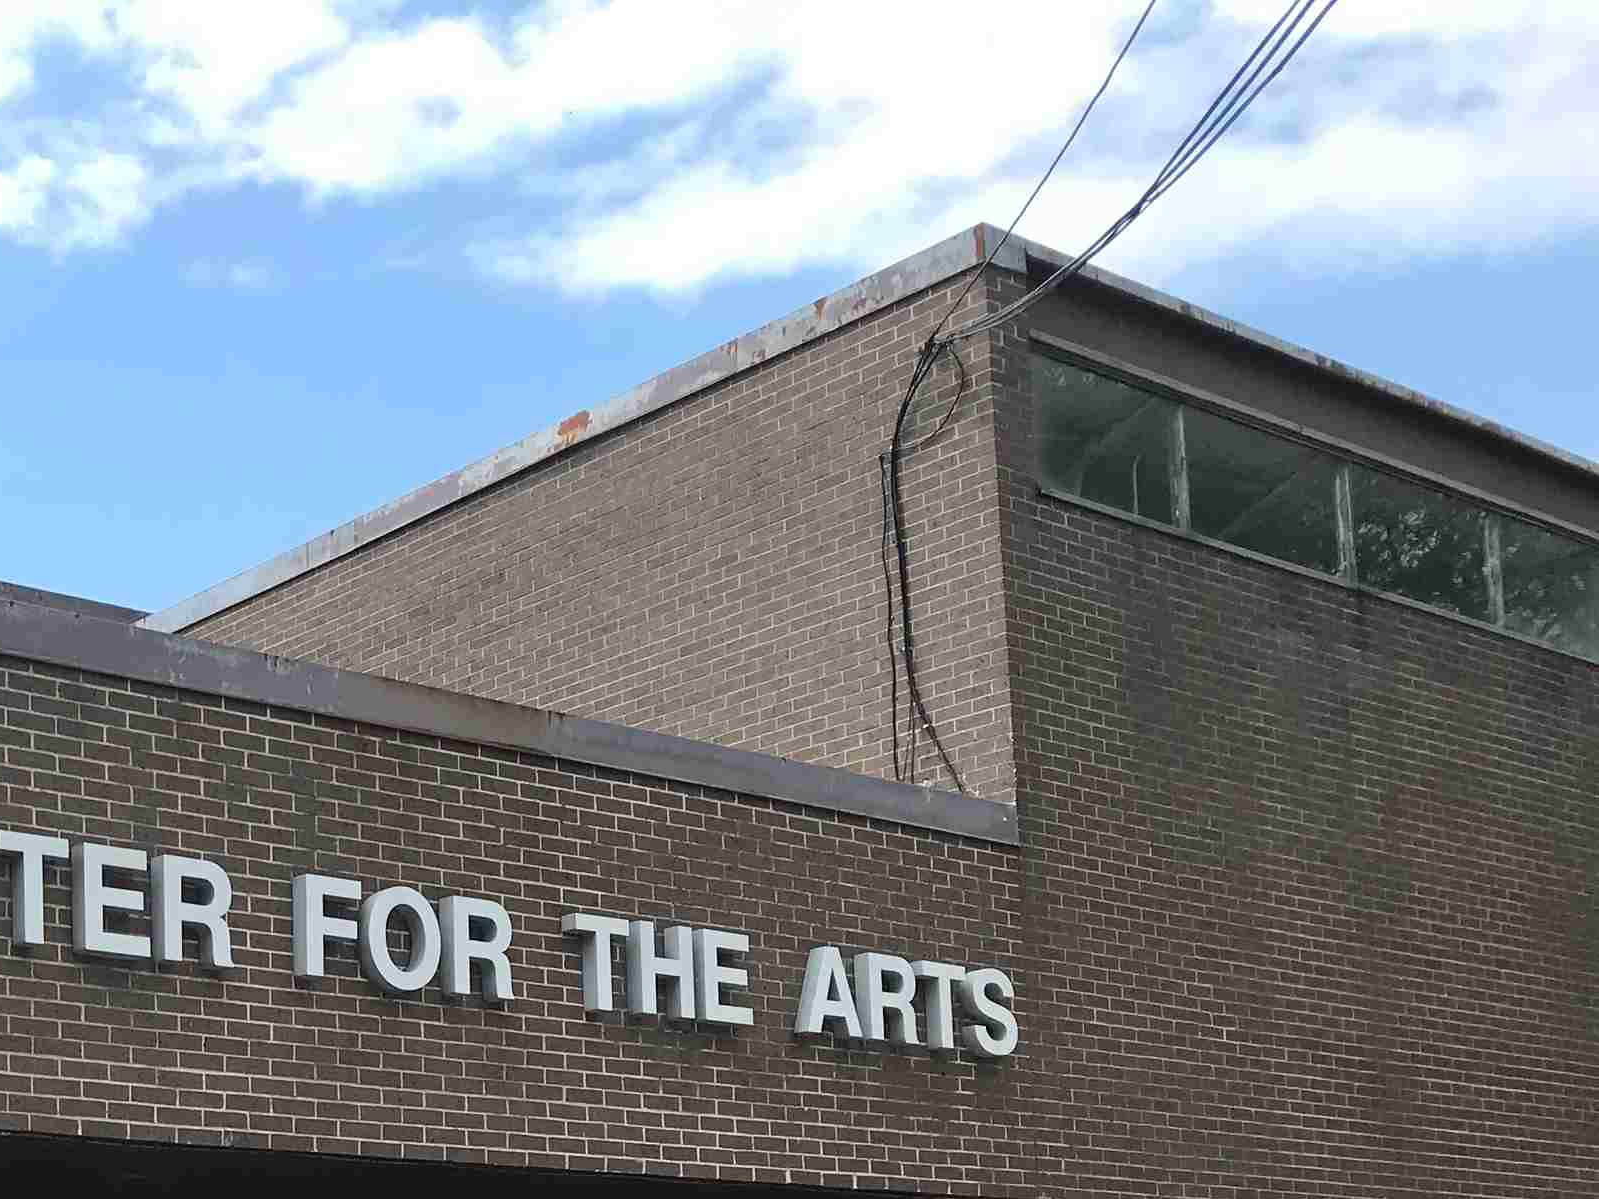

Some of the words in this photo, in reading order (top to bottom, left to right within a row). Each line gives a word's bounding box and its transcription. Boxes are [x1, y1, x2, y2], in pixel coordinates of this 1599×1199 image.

[292, 874, 514, 1000] FOR
[562, 912, 754, 1027] THE
[795, 946, 1018, 1057] ARTS
